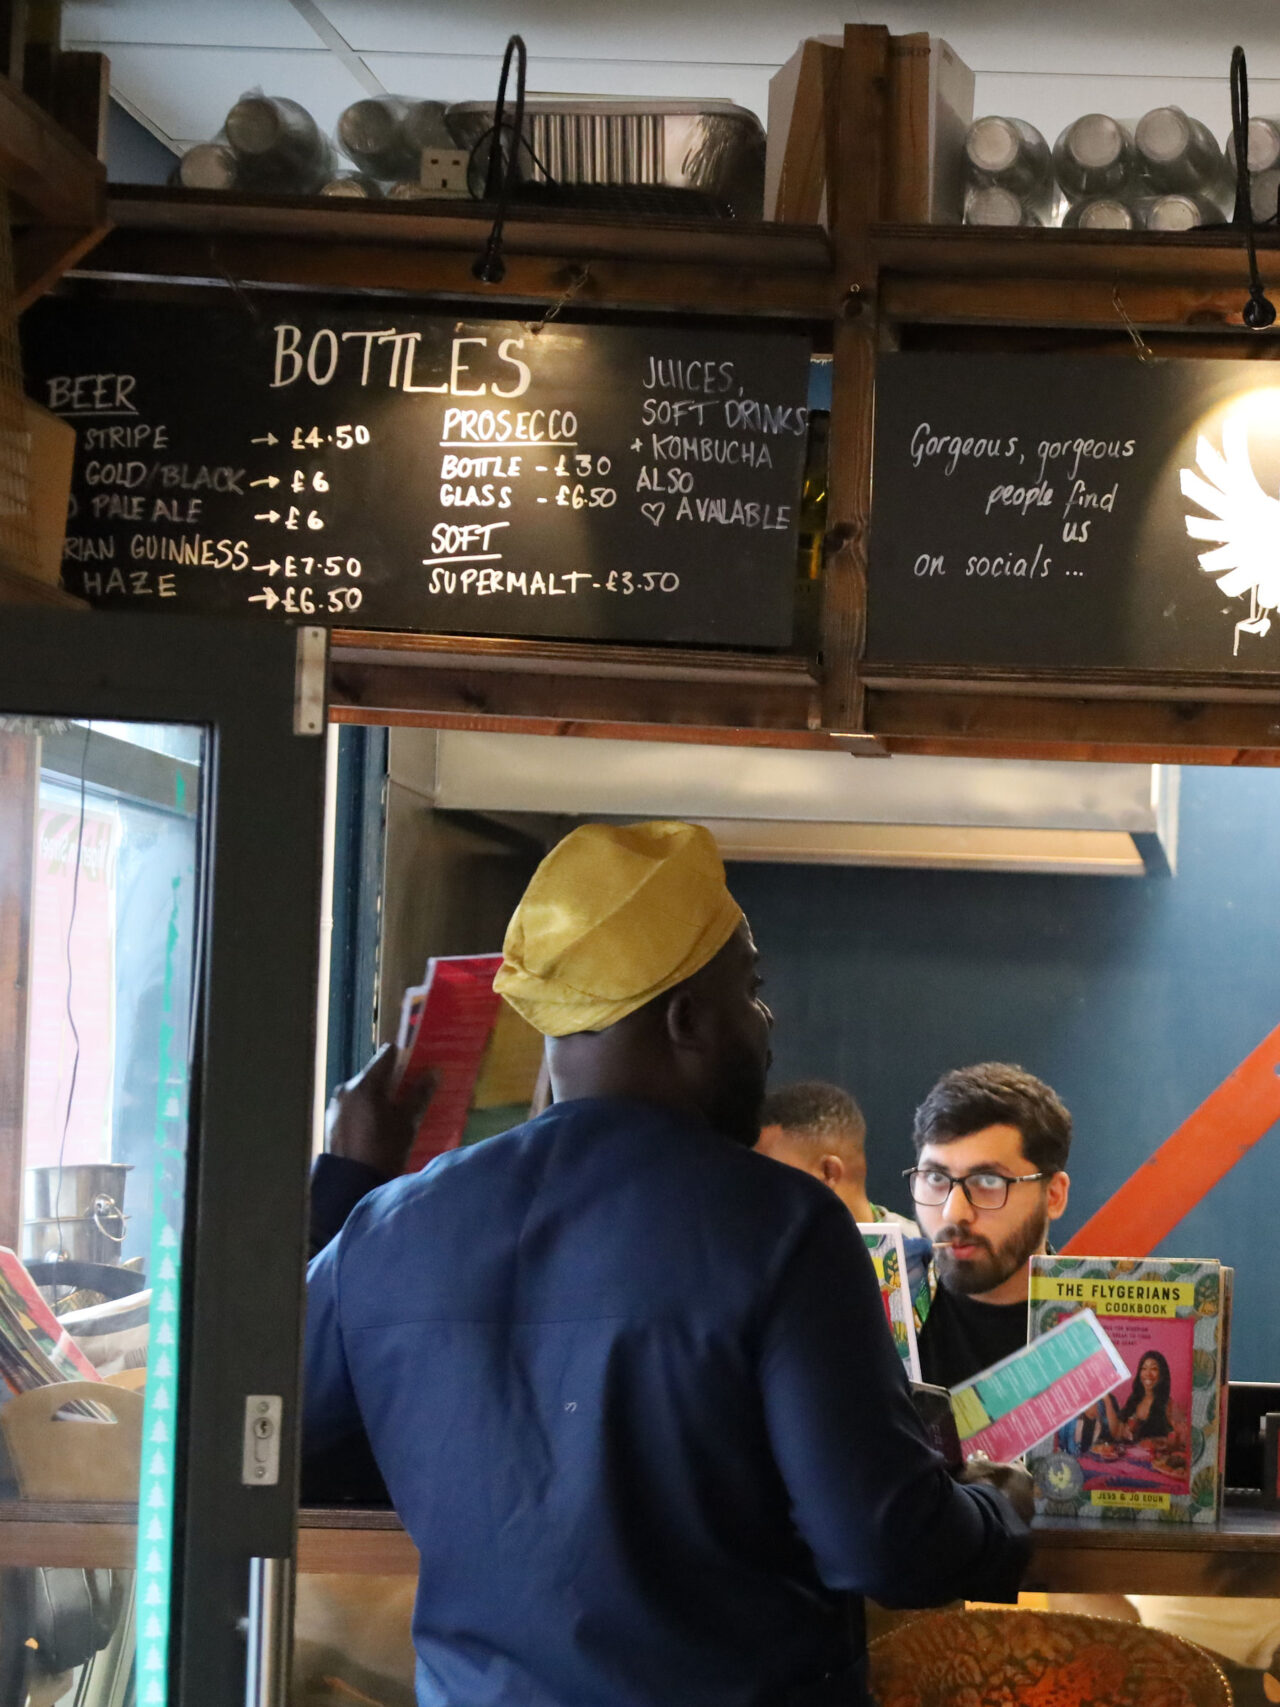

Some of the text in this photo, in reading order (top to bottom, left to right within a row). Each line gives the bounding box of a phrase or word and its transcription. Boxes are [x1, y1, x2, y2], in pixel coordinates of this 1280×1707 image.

[270, 324, 531, 399] BOTTLES
[643, 356, 744, 396] JUICES,
[48, 374, 138, 411] BEER
[442, 408, 578, 442] PROSECCO
[642, 400, 808, 436] SOFT DRINKS
[84, 424, 371, 451] STRIPE £4.50
[652, 433, 773, 469] KOMBUCHA
[910, 422, 1136, 484] Gorgeous, gorgeous
[441, 456, 521, 480] BOTTLE
[637, 466, 695, 494] ALSO
[151, 499, 202, 524] ALE
[440, 485, 513, 509] GLASS
[555, 485, 617, 509] £6.50
[676, 497, 791, 530] AVAILABLE
[985, 479, 1119, 519] people find
[431, 521, 510, 555] SOFT
[1062, 520, 1091, 543] us
[130, 535, 250, 572] GUINNESS
[284, 556, 362, 579] £7.50
[913, 553, 946, 577] on
[965, 544, 1052, 579] socials
[84, 567, 363, 614] HAZE £6.50
[429, 568, 593, 596] SUPERMALT
[605, 571, 680, 594] £3.50
[1056, 1283, 1181, 1301] THE FLYGERIANS
[1105, 1302, 1167, 1315] COOKBOOK
